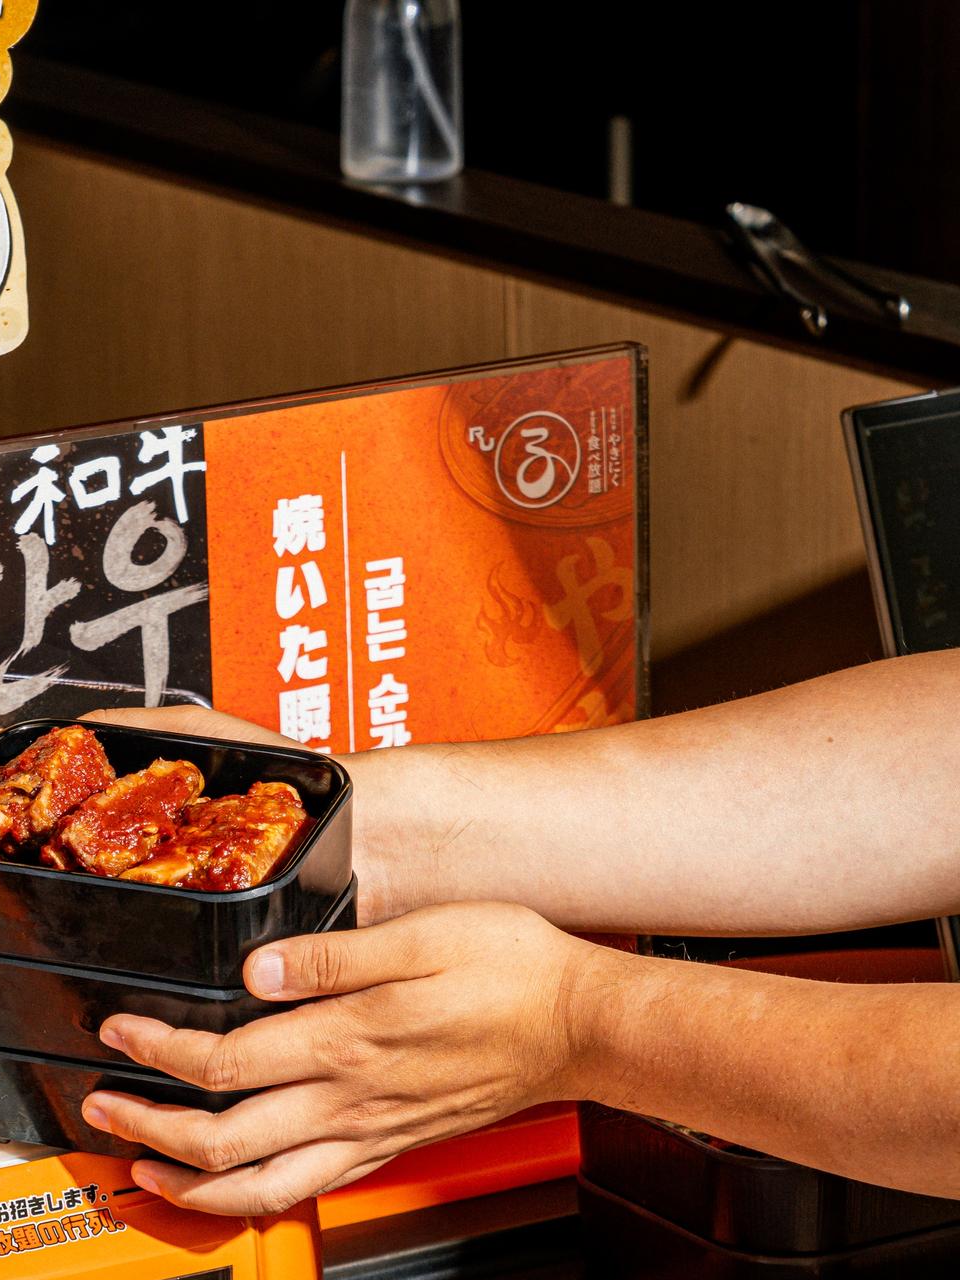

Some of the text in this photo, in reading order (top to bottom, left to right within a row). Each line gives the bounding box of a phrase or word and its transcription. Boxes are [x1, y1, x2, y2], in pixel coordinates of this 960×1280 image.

[11, 424, 207, 543] 和牛
[272, 494, 332, 754] 焼いた瞬
[363, 557, 407, 663] 굽는
